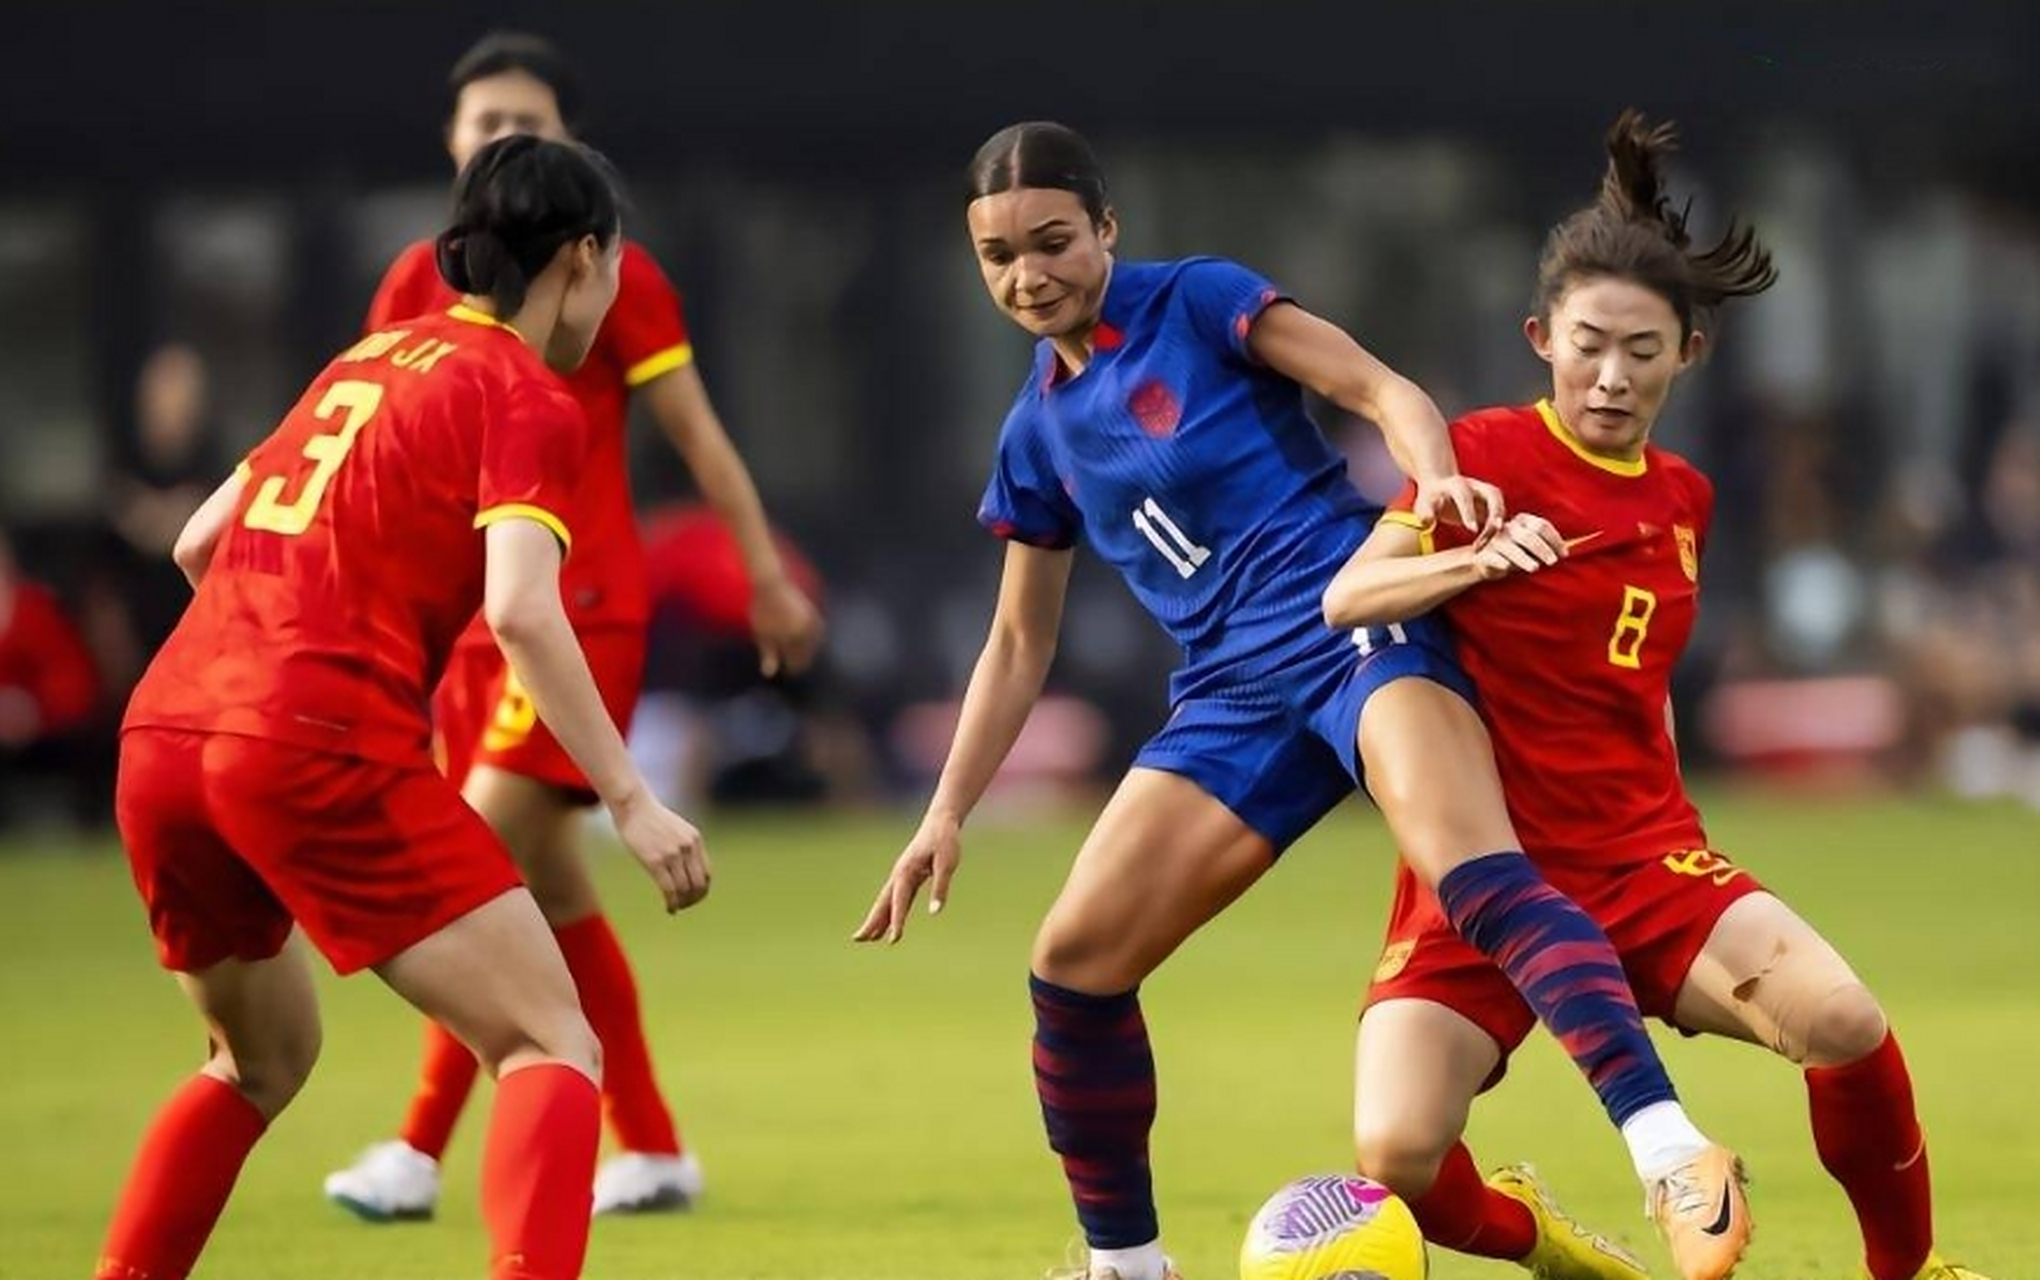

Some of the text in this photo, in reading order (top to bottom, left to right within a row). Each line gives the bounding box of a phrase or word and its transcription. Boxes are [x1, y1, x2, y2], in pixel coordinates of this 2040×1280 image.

[391, 338, 458, 373] JX
[244, 380, 384, 535] 3
[1132, 497, 1211, 580] 11
[1608, 584, 1657, 669] 8
